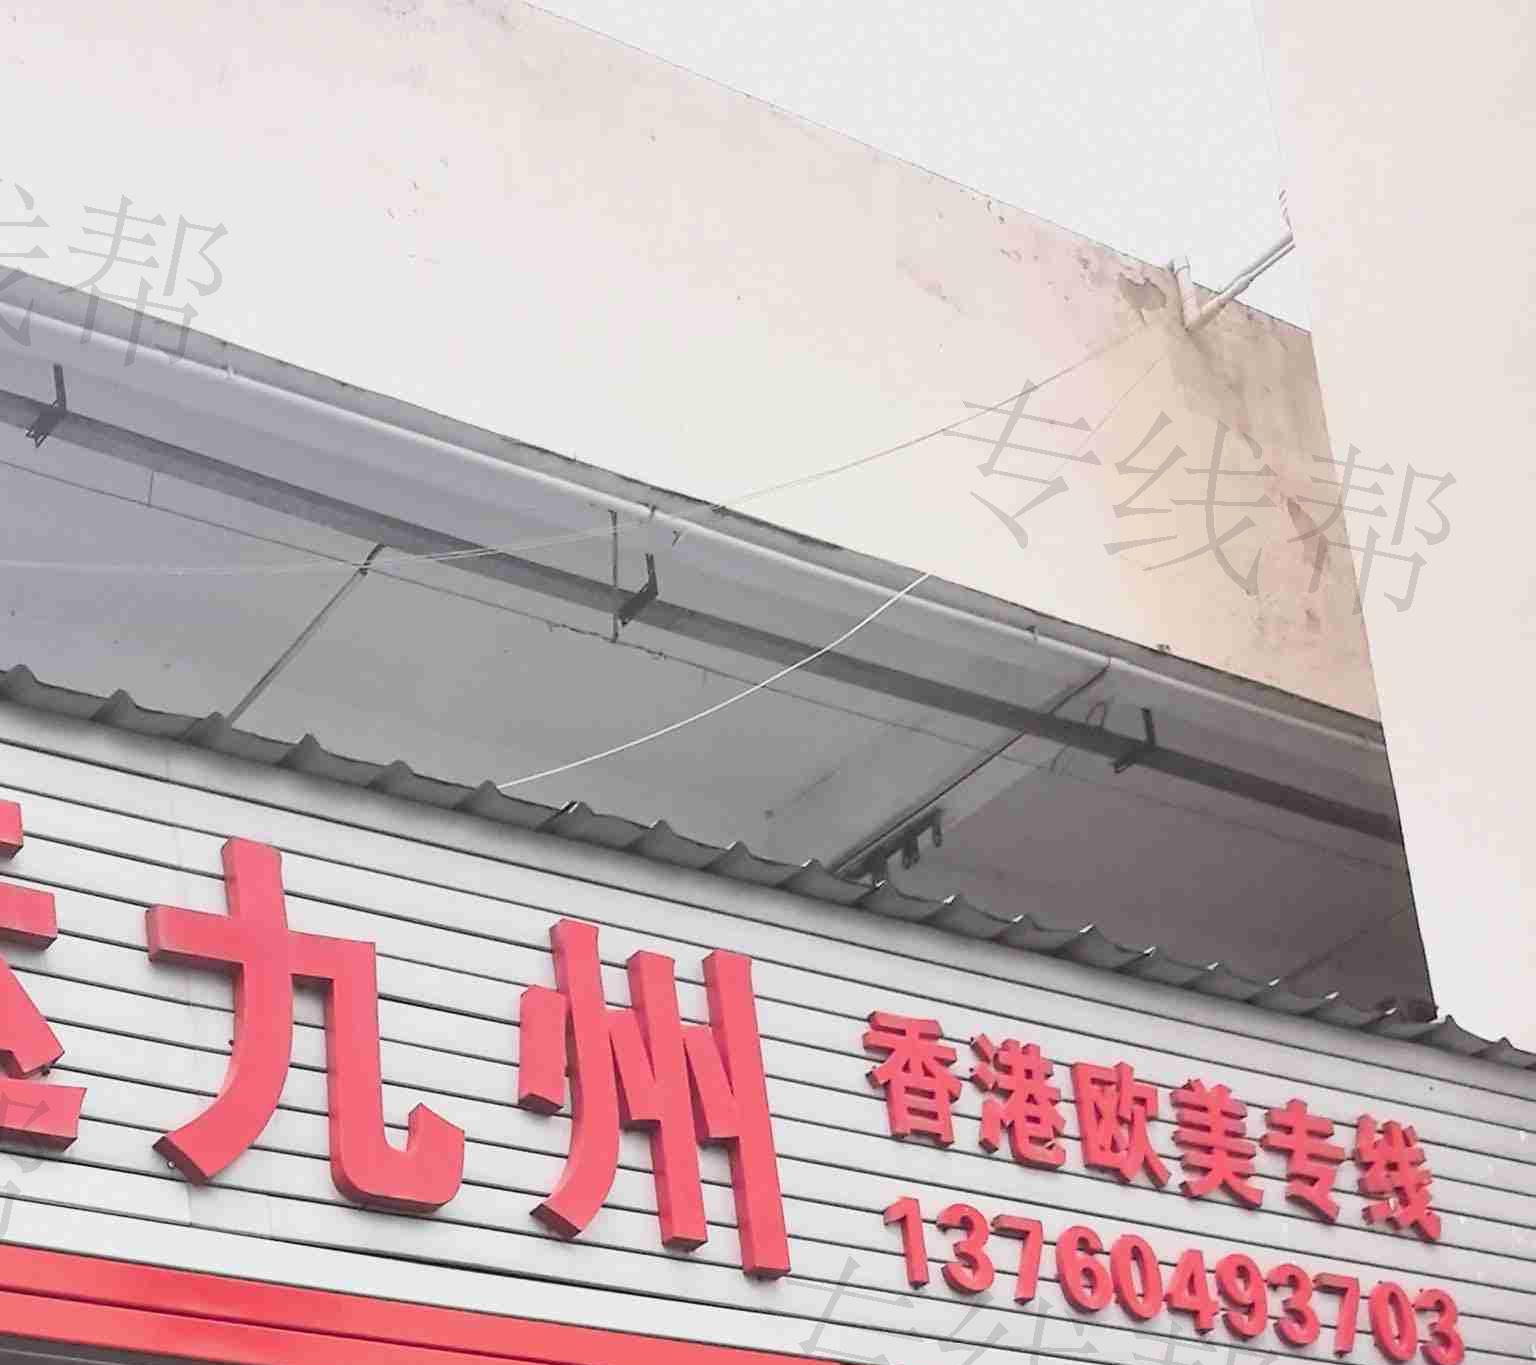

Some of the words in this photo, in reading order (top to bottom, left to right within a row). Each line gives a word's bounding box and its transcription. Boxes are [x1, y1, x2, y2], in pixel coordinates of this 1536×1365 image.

[862, 1010, 1441, 1243] 香港欧美专线
